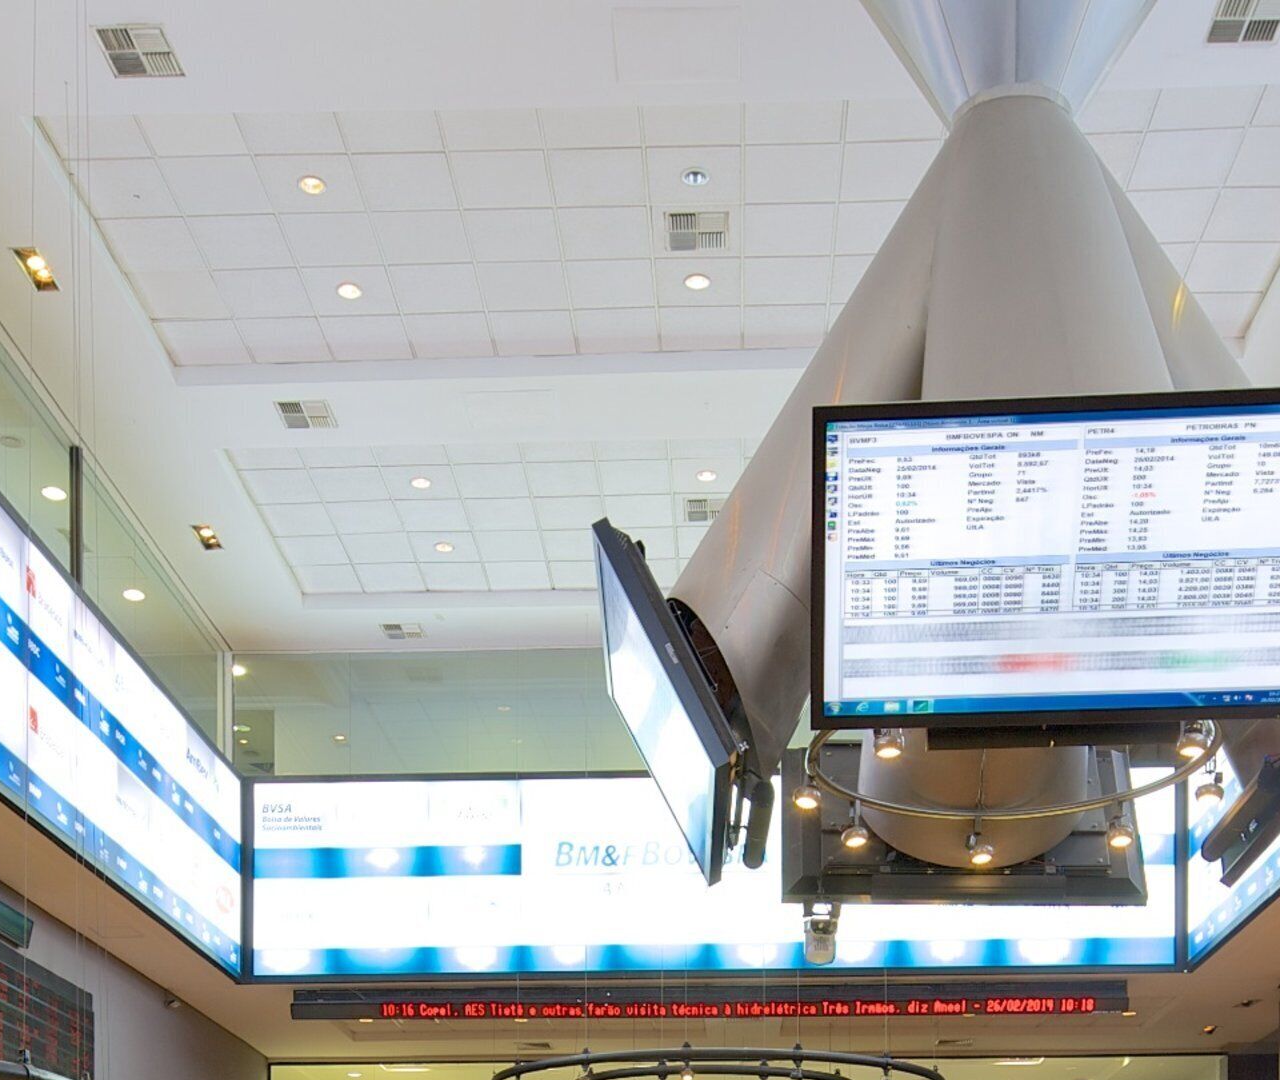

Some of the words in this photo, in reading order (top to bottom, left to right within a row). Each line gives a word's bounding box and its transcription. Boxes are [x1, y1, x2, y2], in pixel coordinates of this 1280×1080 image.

[262, 804, 292, 814] BVSA
[382, 1004, 414, 1016] 10:16
[465, 1004, 485, 1016] AES
[528, 1006, 537, 1016] e
[542, 1005, 582, 1016] outras
[626, 1004, 666, 1016] visita
[671, 1003, 719, 1016] técnica
[736, 1003, 817, 1015] hidrelétrica
[908, 1001, 928, 1013] diz
[986, 998, 1054, 1012] 26/02/2014
